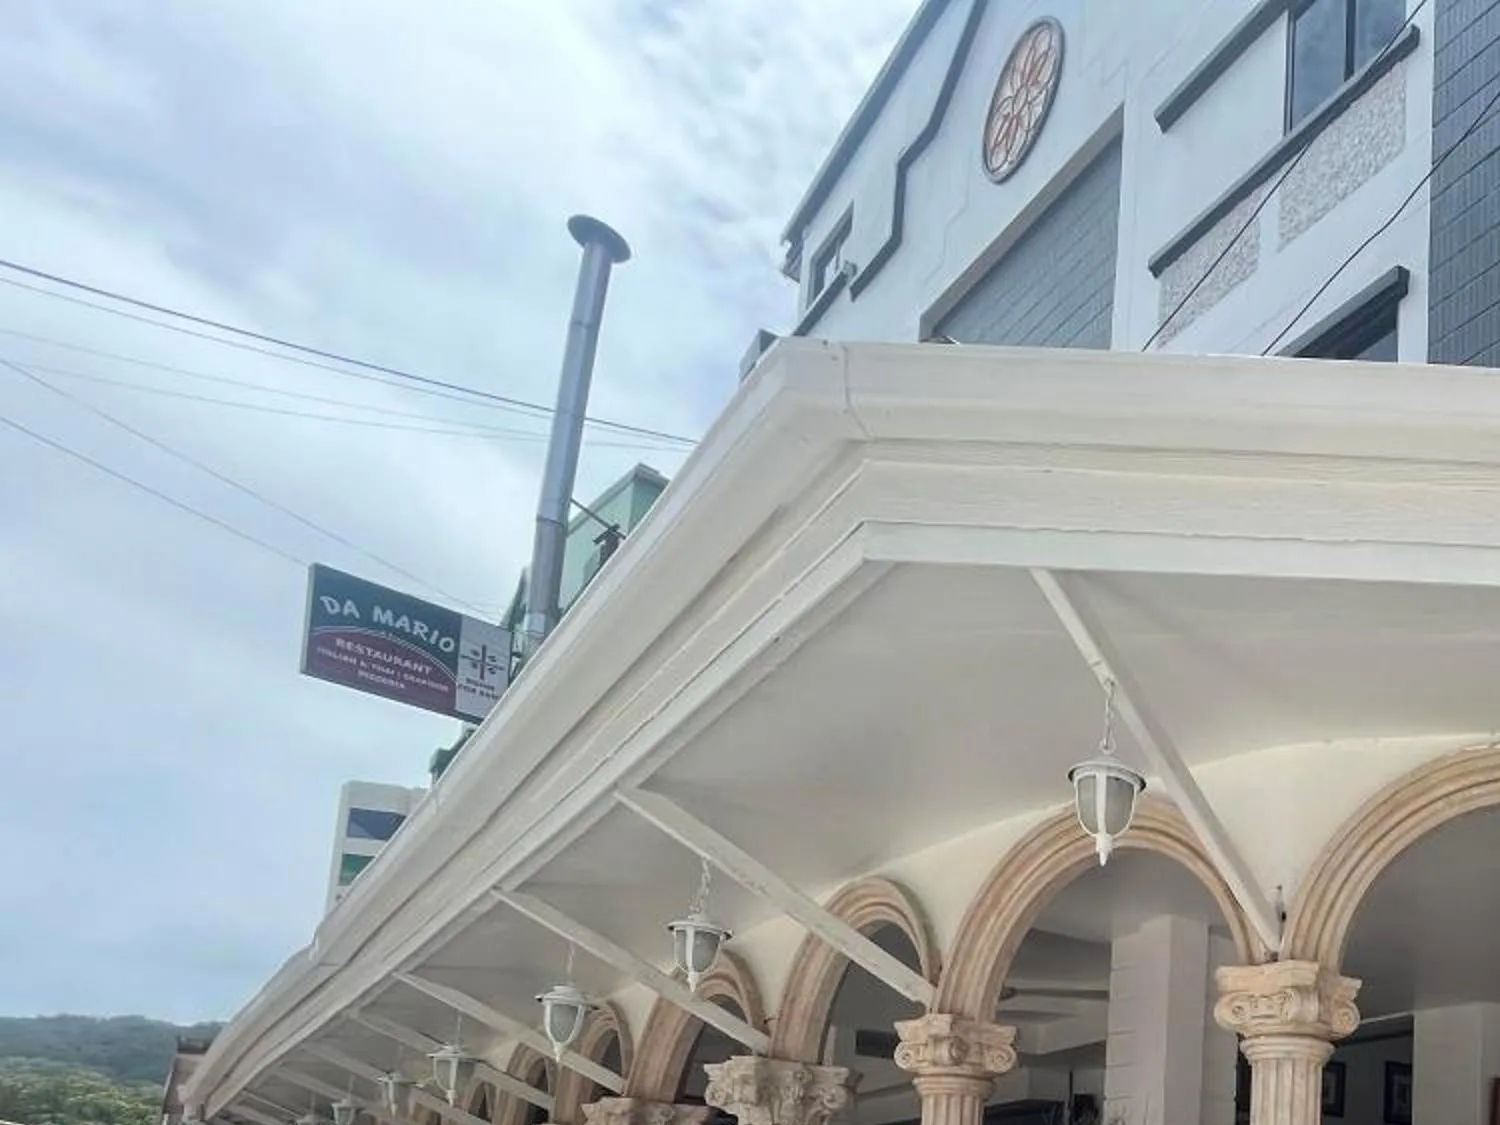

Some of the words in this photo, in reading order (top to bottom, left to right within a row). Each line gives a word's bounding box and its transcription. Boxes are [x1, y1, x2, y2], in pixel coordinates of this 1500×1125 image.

[319, 595, 361, 619] DA
[372, 604, 455, 653] MARIO
[335, 637, 432, 675] RESTAURANT
